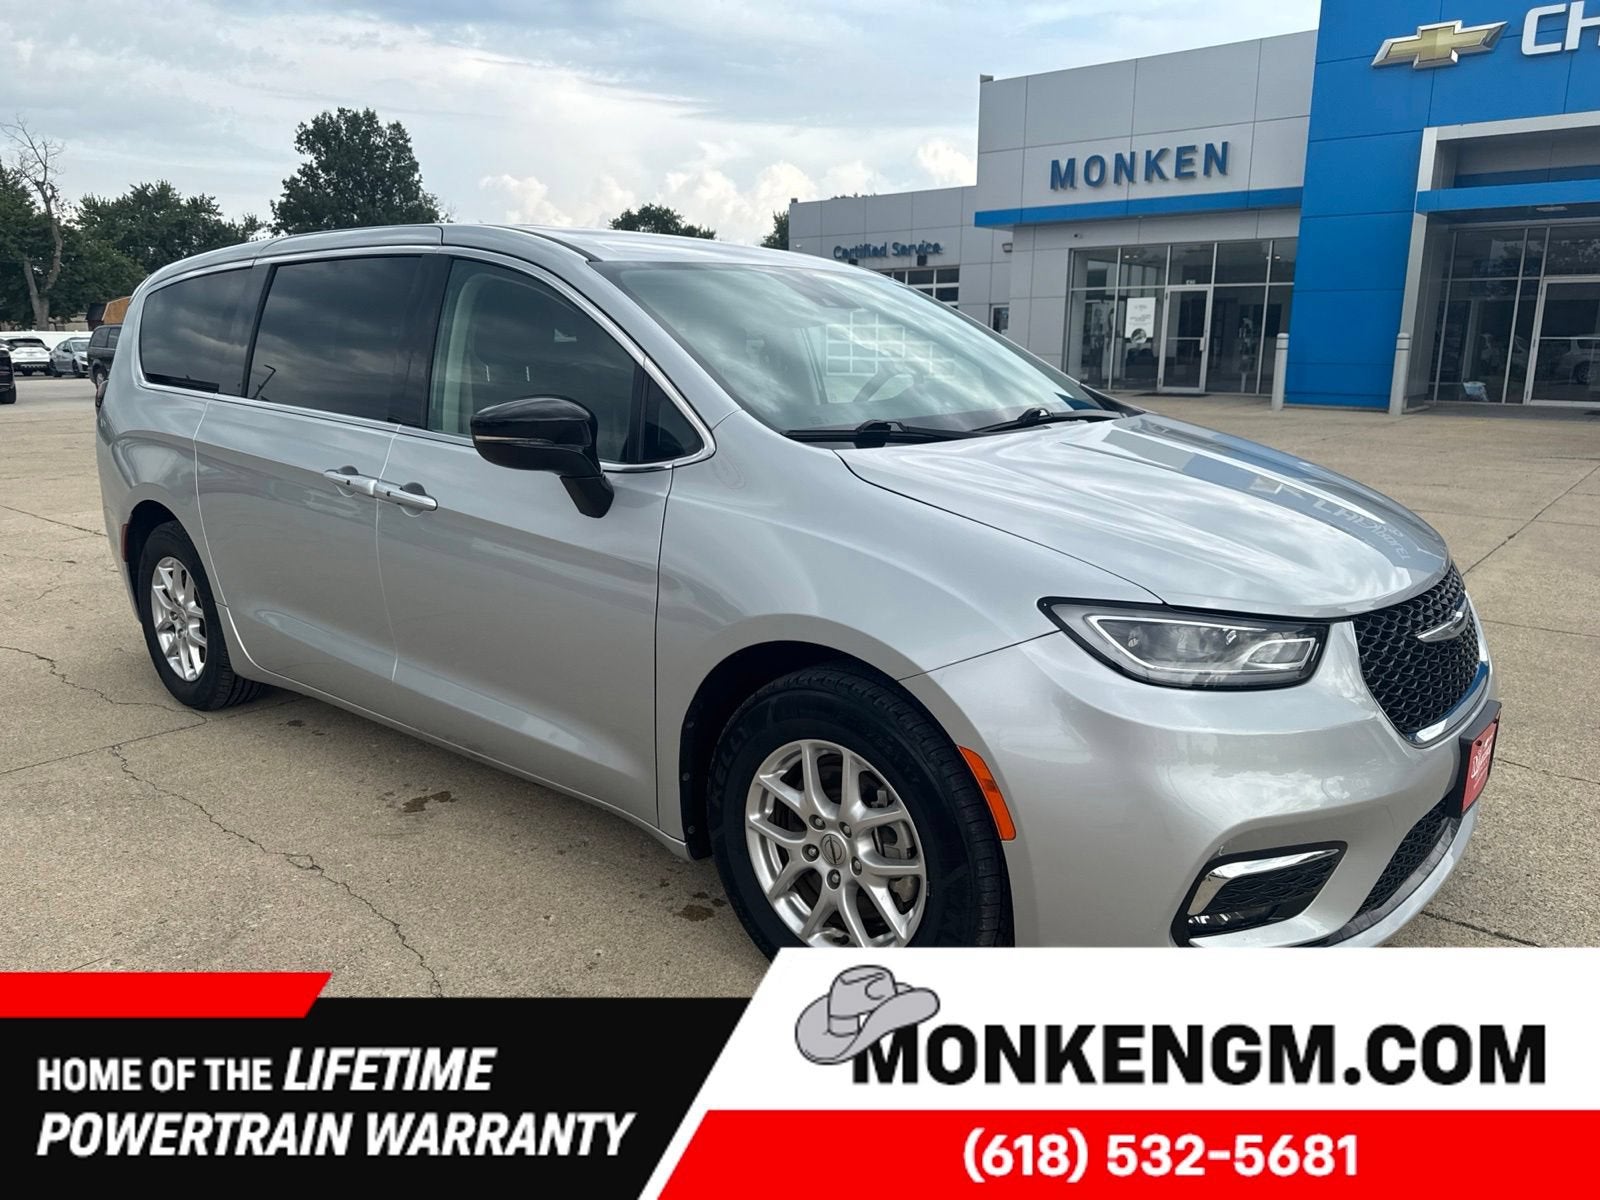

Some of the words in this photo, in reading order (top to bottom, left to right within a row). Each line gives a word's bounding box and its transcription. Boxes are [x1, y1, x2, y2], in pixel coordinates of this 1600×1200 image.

[1050, 141, 1230, 191] MONKEN
[833, 242, 887, 259] Certified
[892, 240, 941, 256] Service
